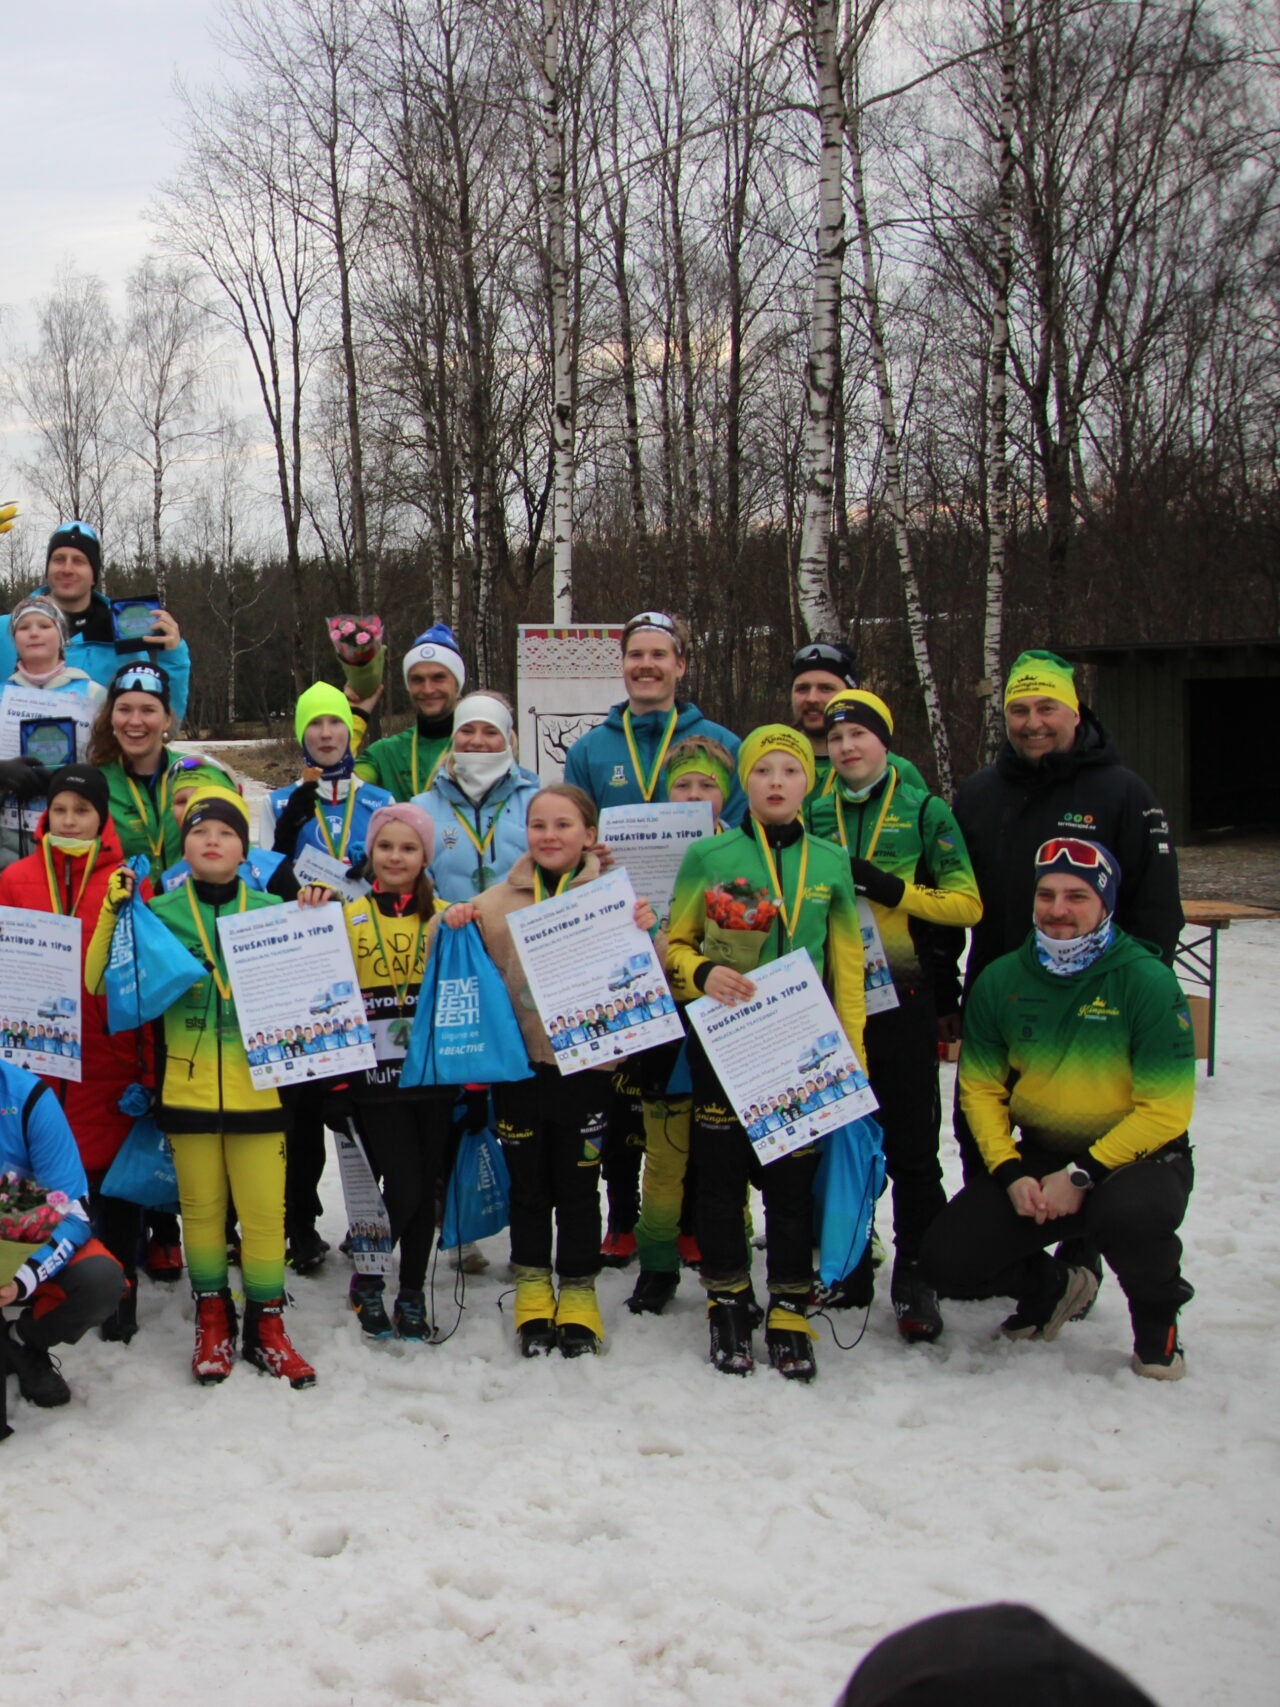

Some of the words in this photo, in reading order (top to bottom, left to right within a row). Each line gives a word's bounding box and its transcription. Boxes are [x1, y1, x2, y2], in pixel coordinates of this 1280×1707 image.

[361, 798, 383, 808] BMW
[439, 1043, 486, 1056] #BEACTIVE
[37, 1237, 74, 1282] EESTI
